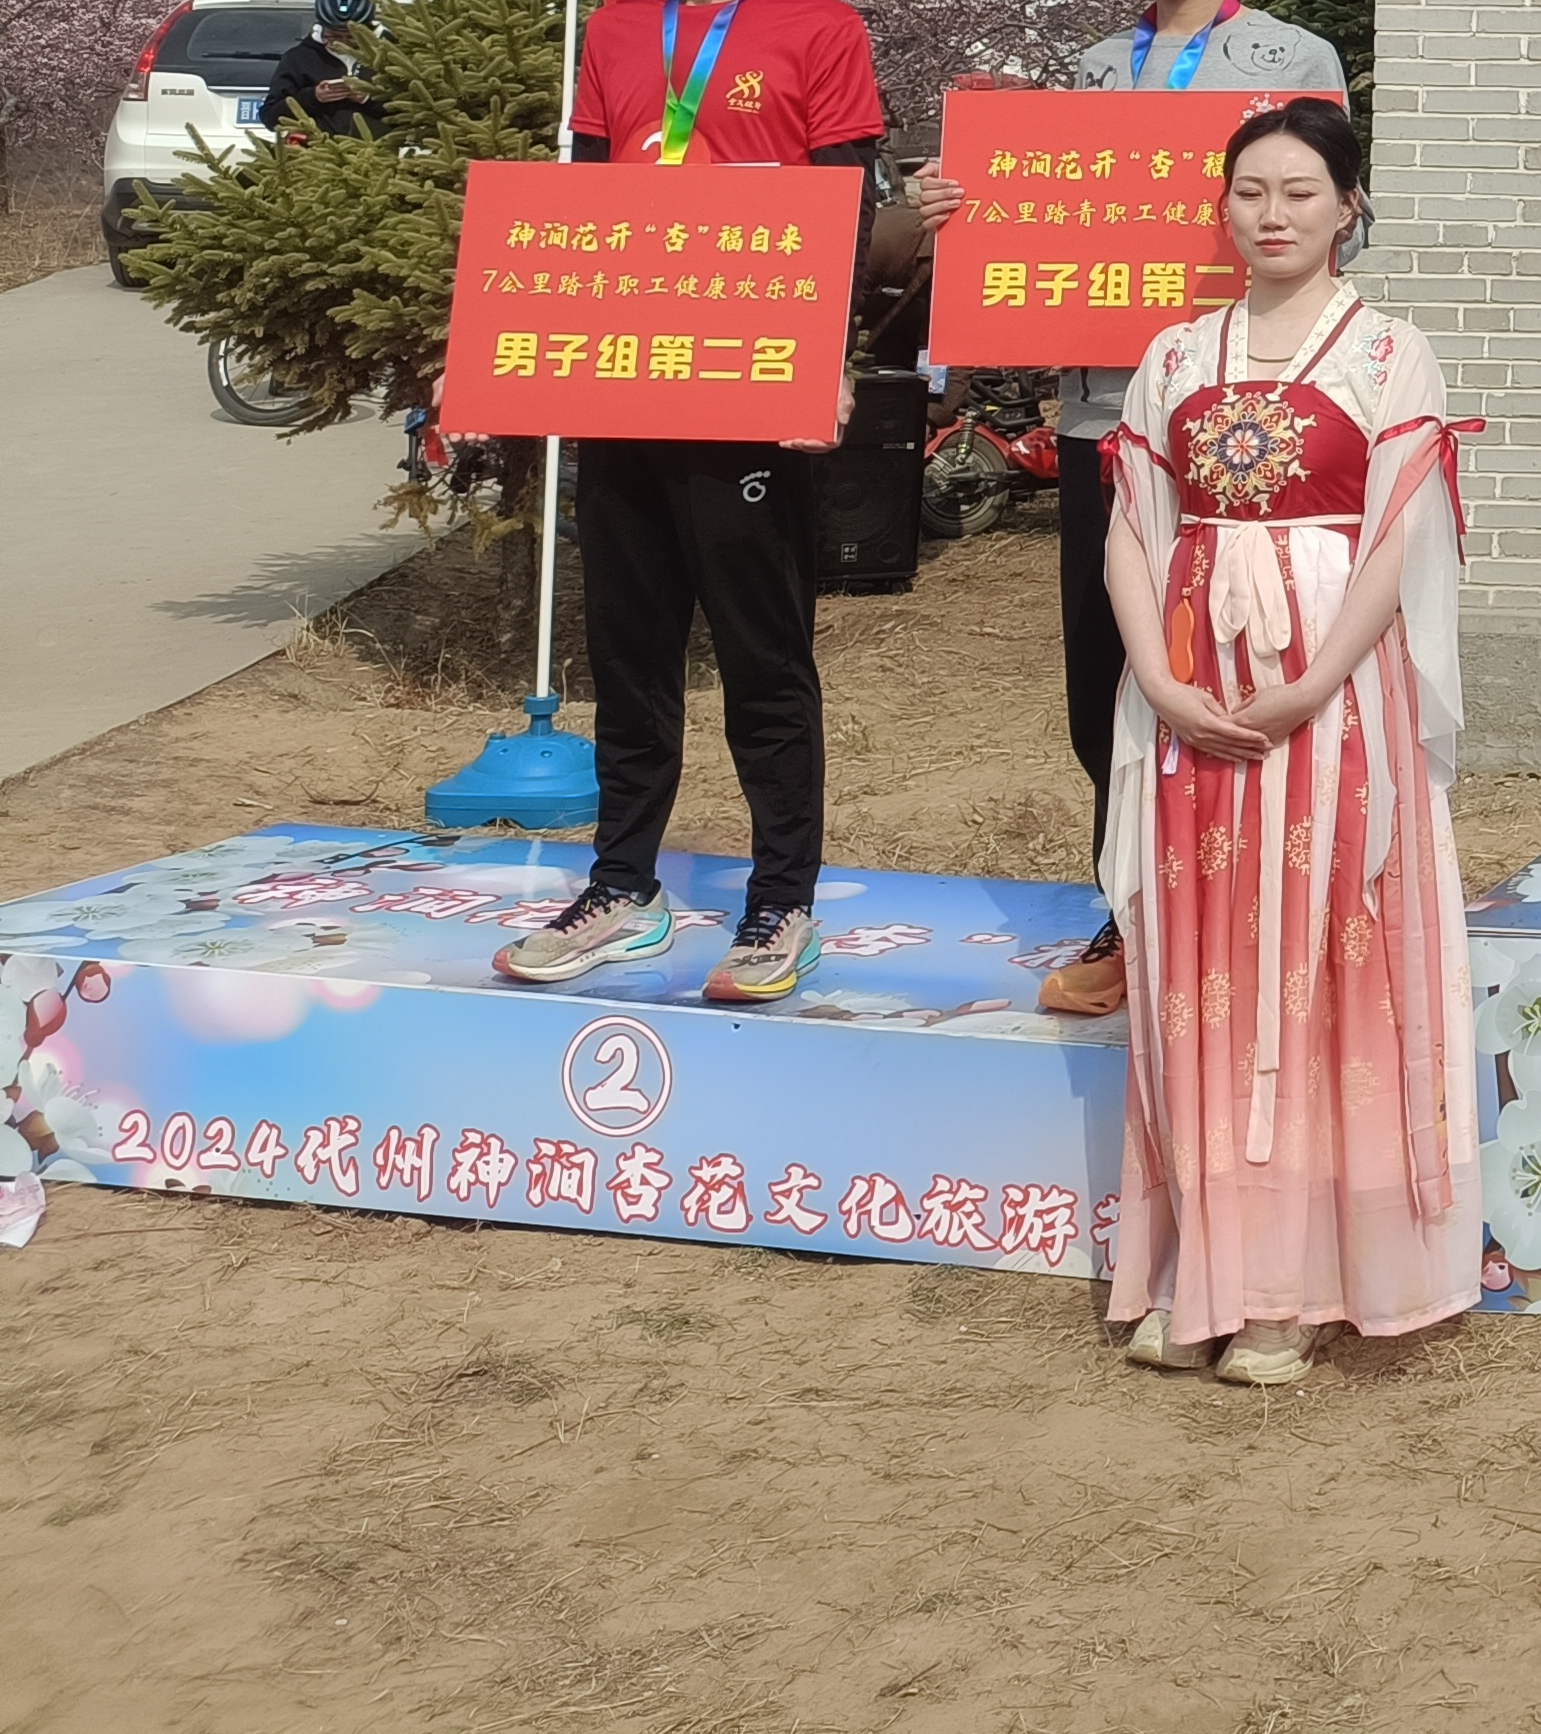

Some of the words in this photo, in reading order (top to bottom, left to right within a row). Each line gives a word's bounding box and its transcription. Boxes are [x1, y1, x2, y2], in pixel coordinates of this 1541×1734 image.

[506, 220, 803, 256] 神涧花开“杏”福自来
[482, 268, 819, 302] 7公里踏青职工健康欢乐跑
[982, 260, 1252, 309] 男子组第二
[492, 331, 798, 384] 男子组第二名
